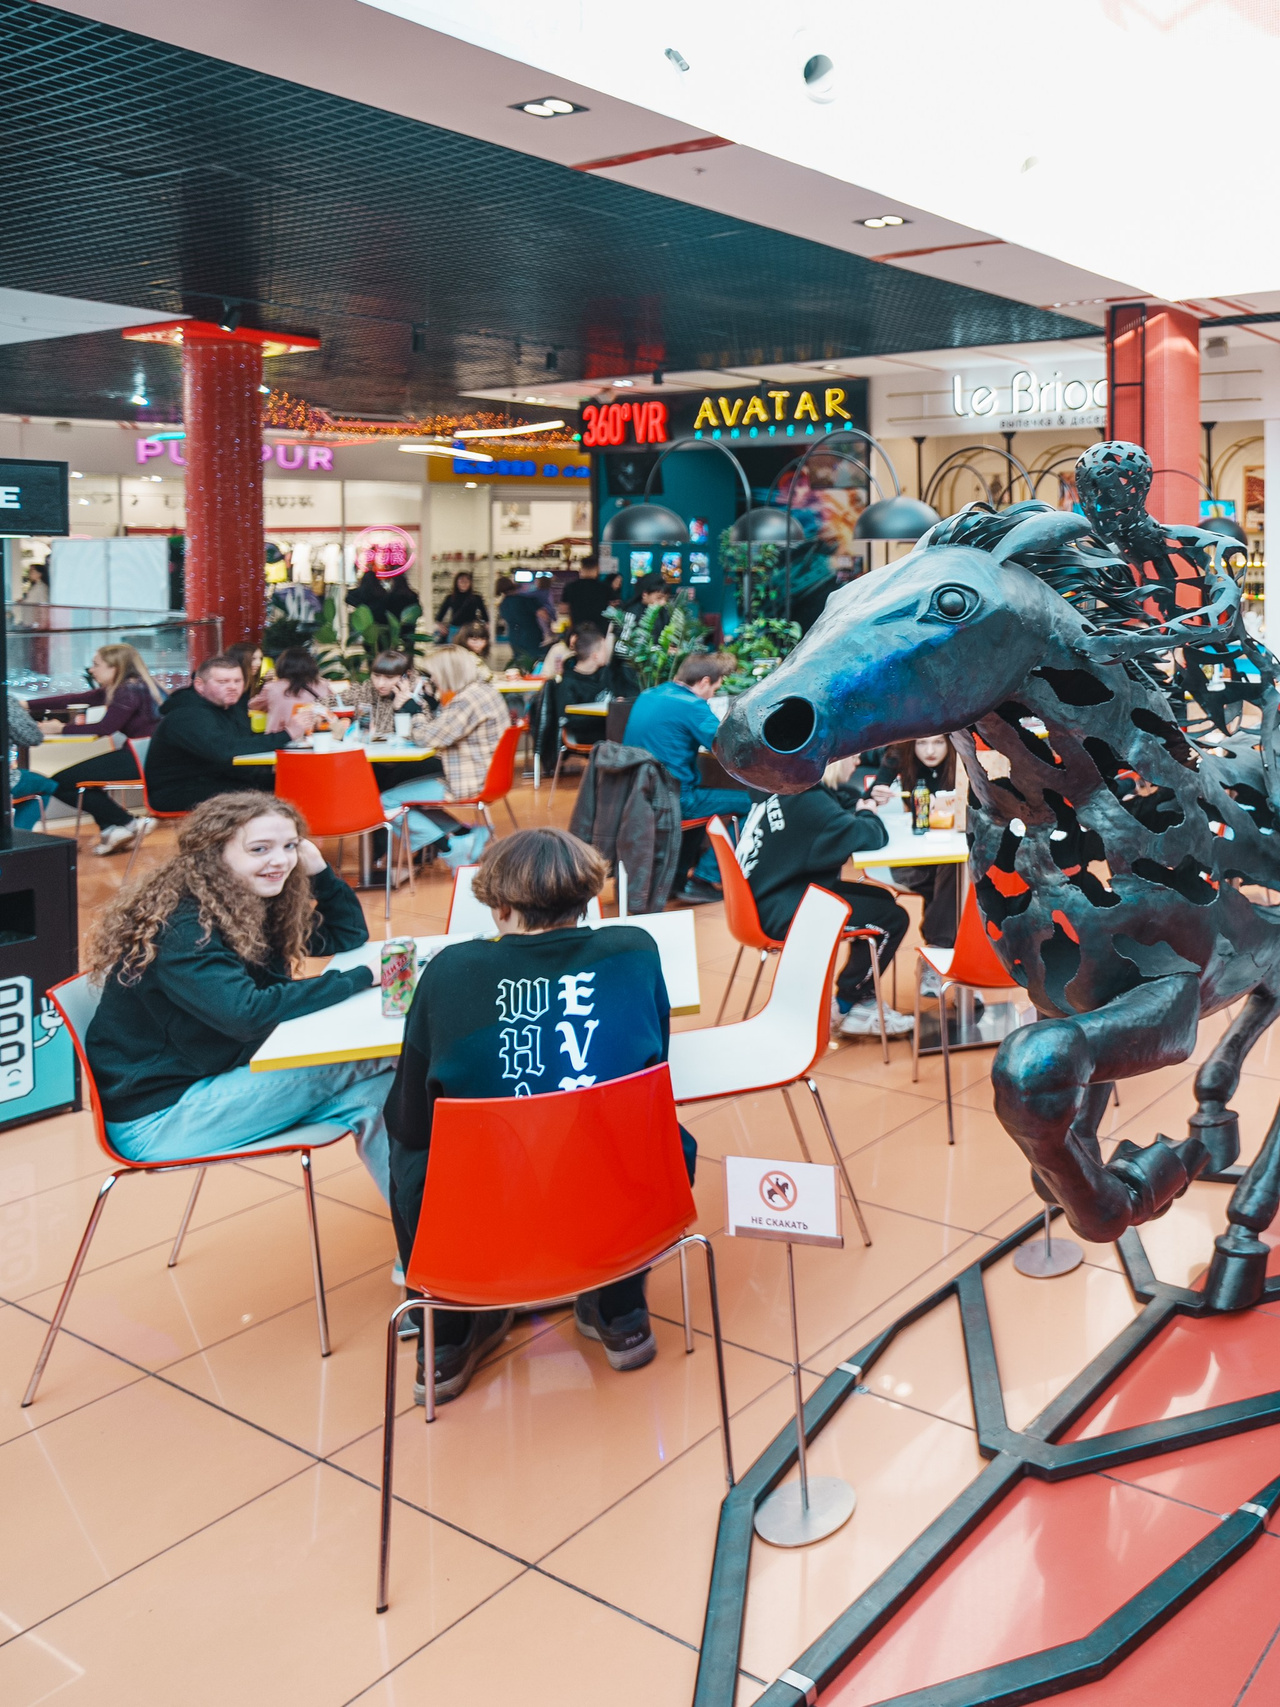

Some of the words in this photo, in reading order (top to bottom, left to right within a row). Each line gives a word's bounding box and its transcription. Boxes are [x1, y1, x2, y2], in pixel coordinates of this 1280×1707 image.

[693, 387, 853, 430] AVATAR
[750, 1216, 763, 1225] НЕ
[765, 1217, 809, 1230] СКАКАТЬ
